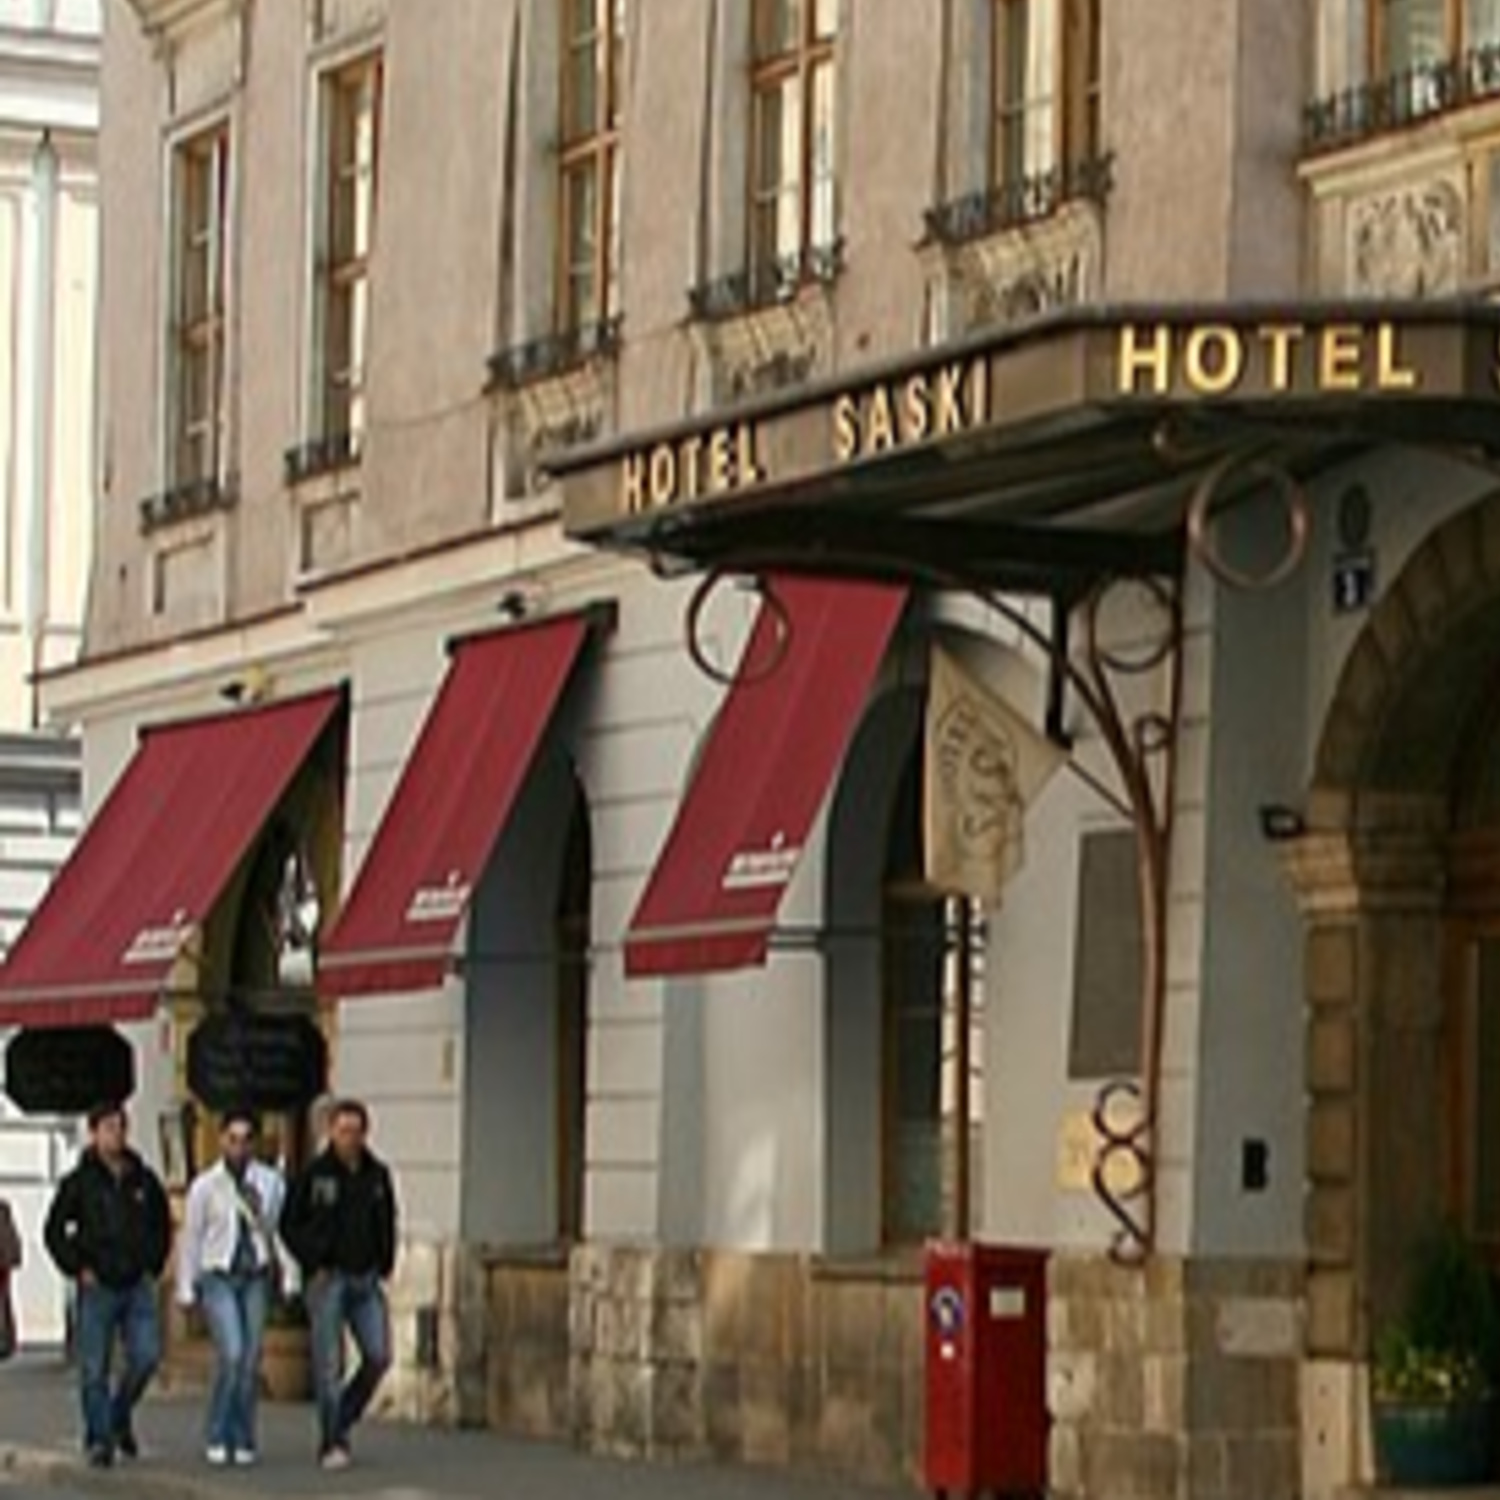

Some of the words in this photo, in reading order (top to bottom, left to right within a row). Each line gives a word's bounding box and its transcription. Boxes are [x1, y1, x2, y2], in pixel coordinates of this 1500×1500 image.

[1117, 322, 1416, 394] HOTEL
[621, 422, 762, 514] HOTEL
[832, 357, 990, 462] SASKI
